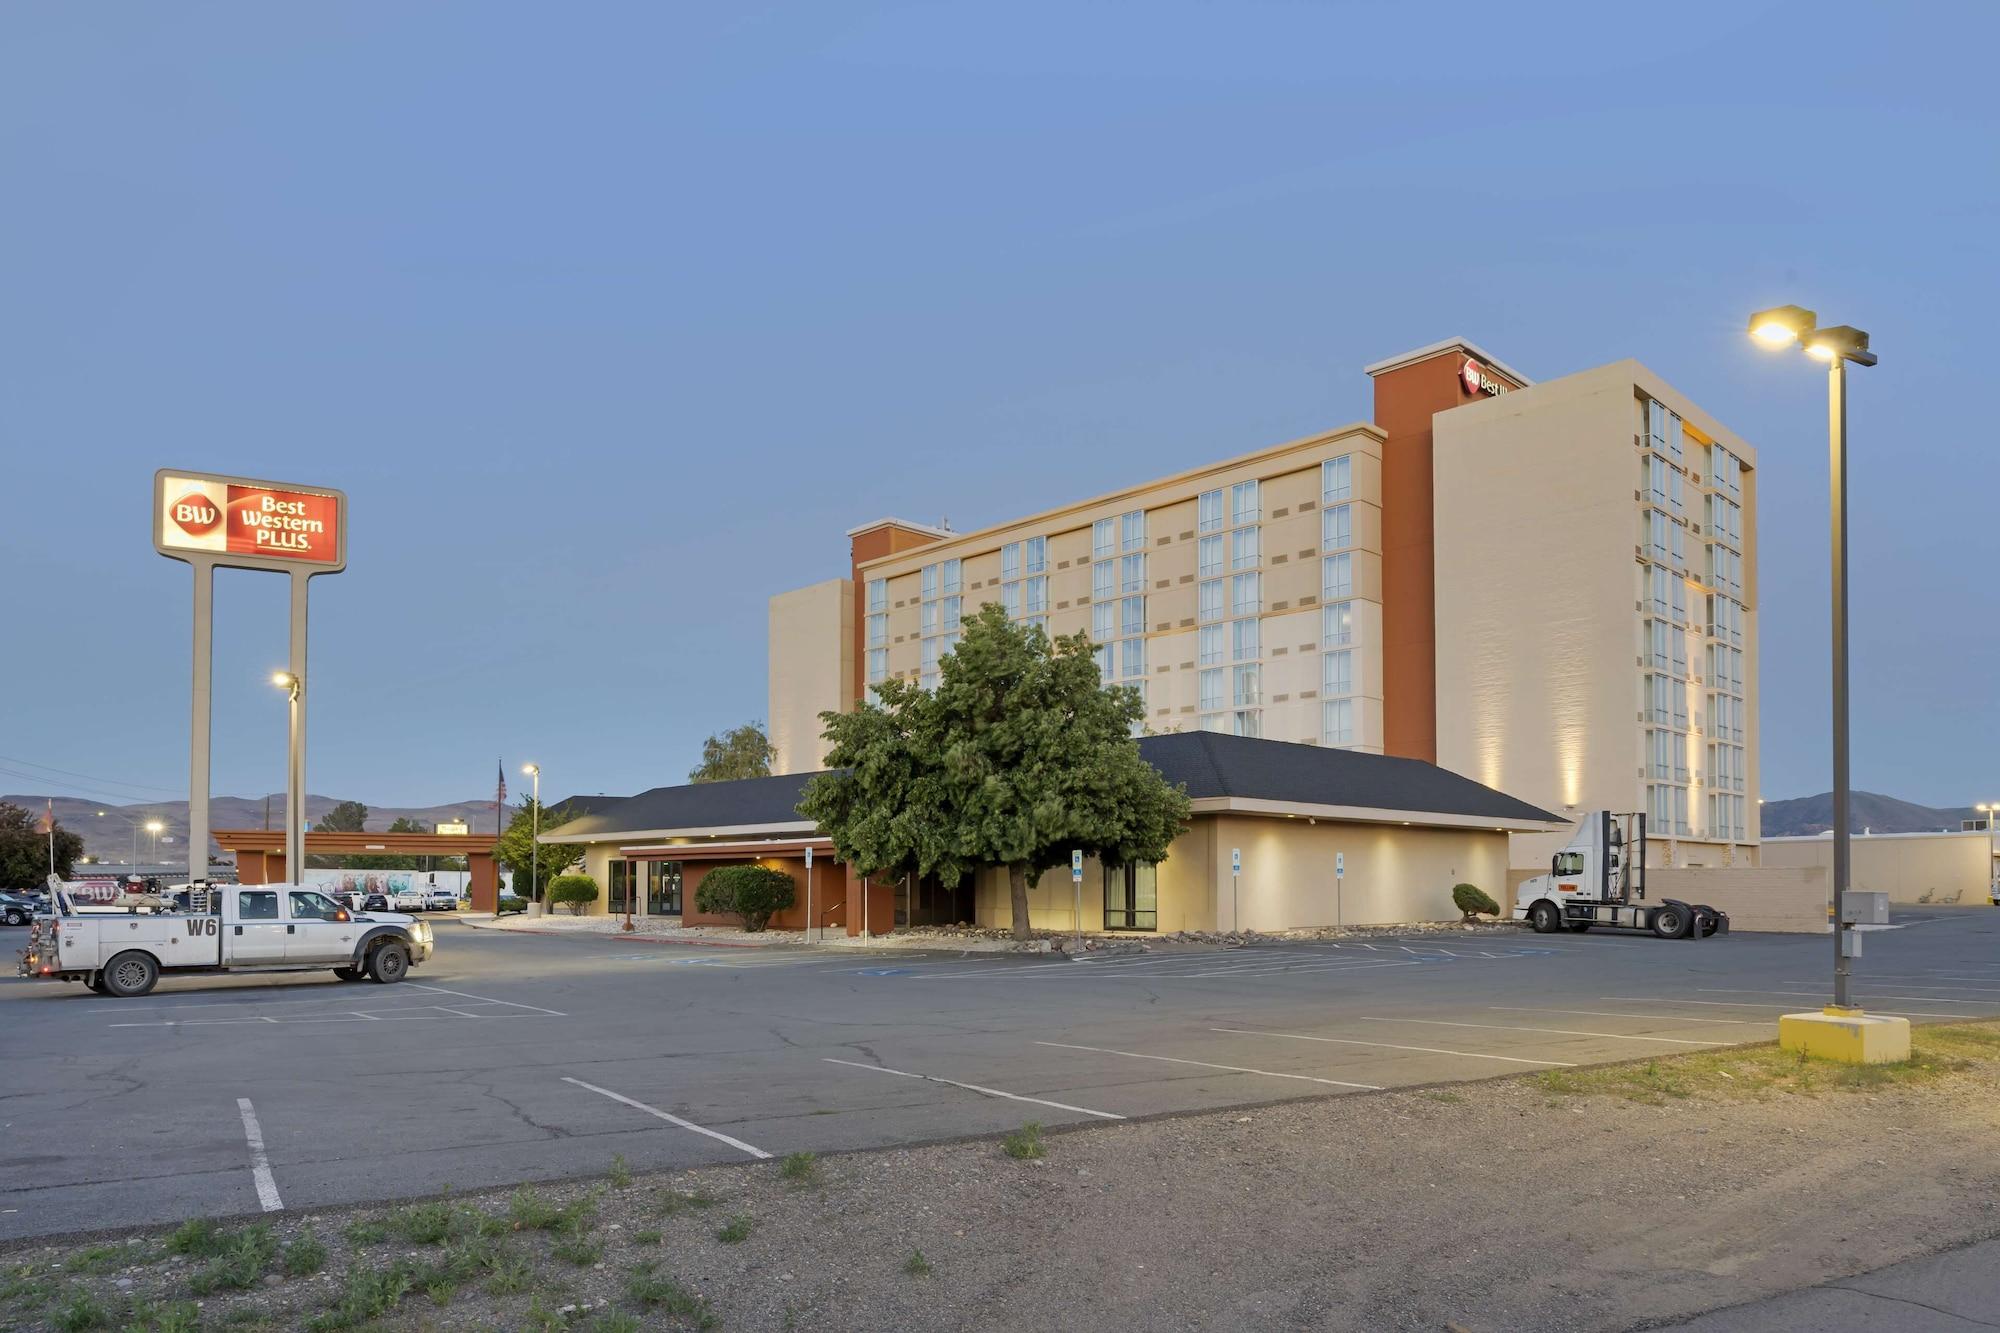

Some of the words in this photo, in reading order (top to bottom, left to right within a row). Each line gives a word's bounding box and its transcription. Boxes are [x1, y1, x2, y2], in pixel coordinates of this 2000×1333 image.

[1465, 367, 1480, 386] BW
[1481, 374, 1501, 397] Best
[176, 504, 216, 525] BW
[261, 496, 306, 516] Best
[241, 509, 324, 534] Western
[186, 918, 217, 936] W6
